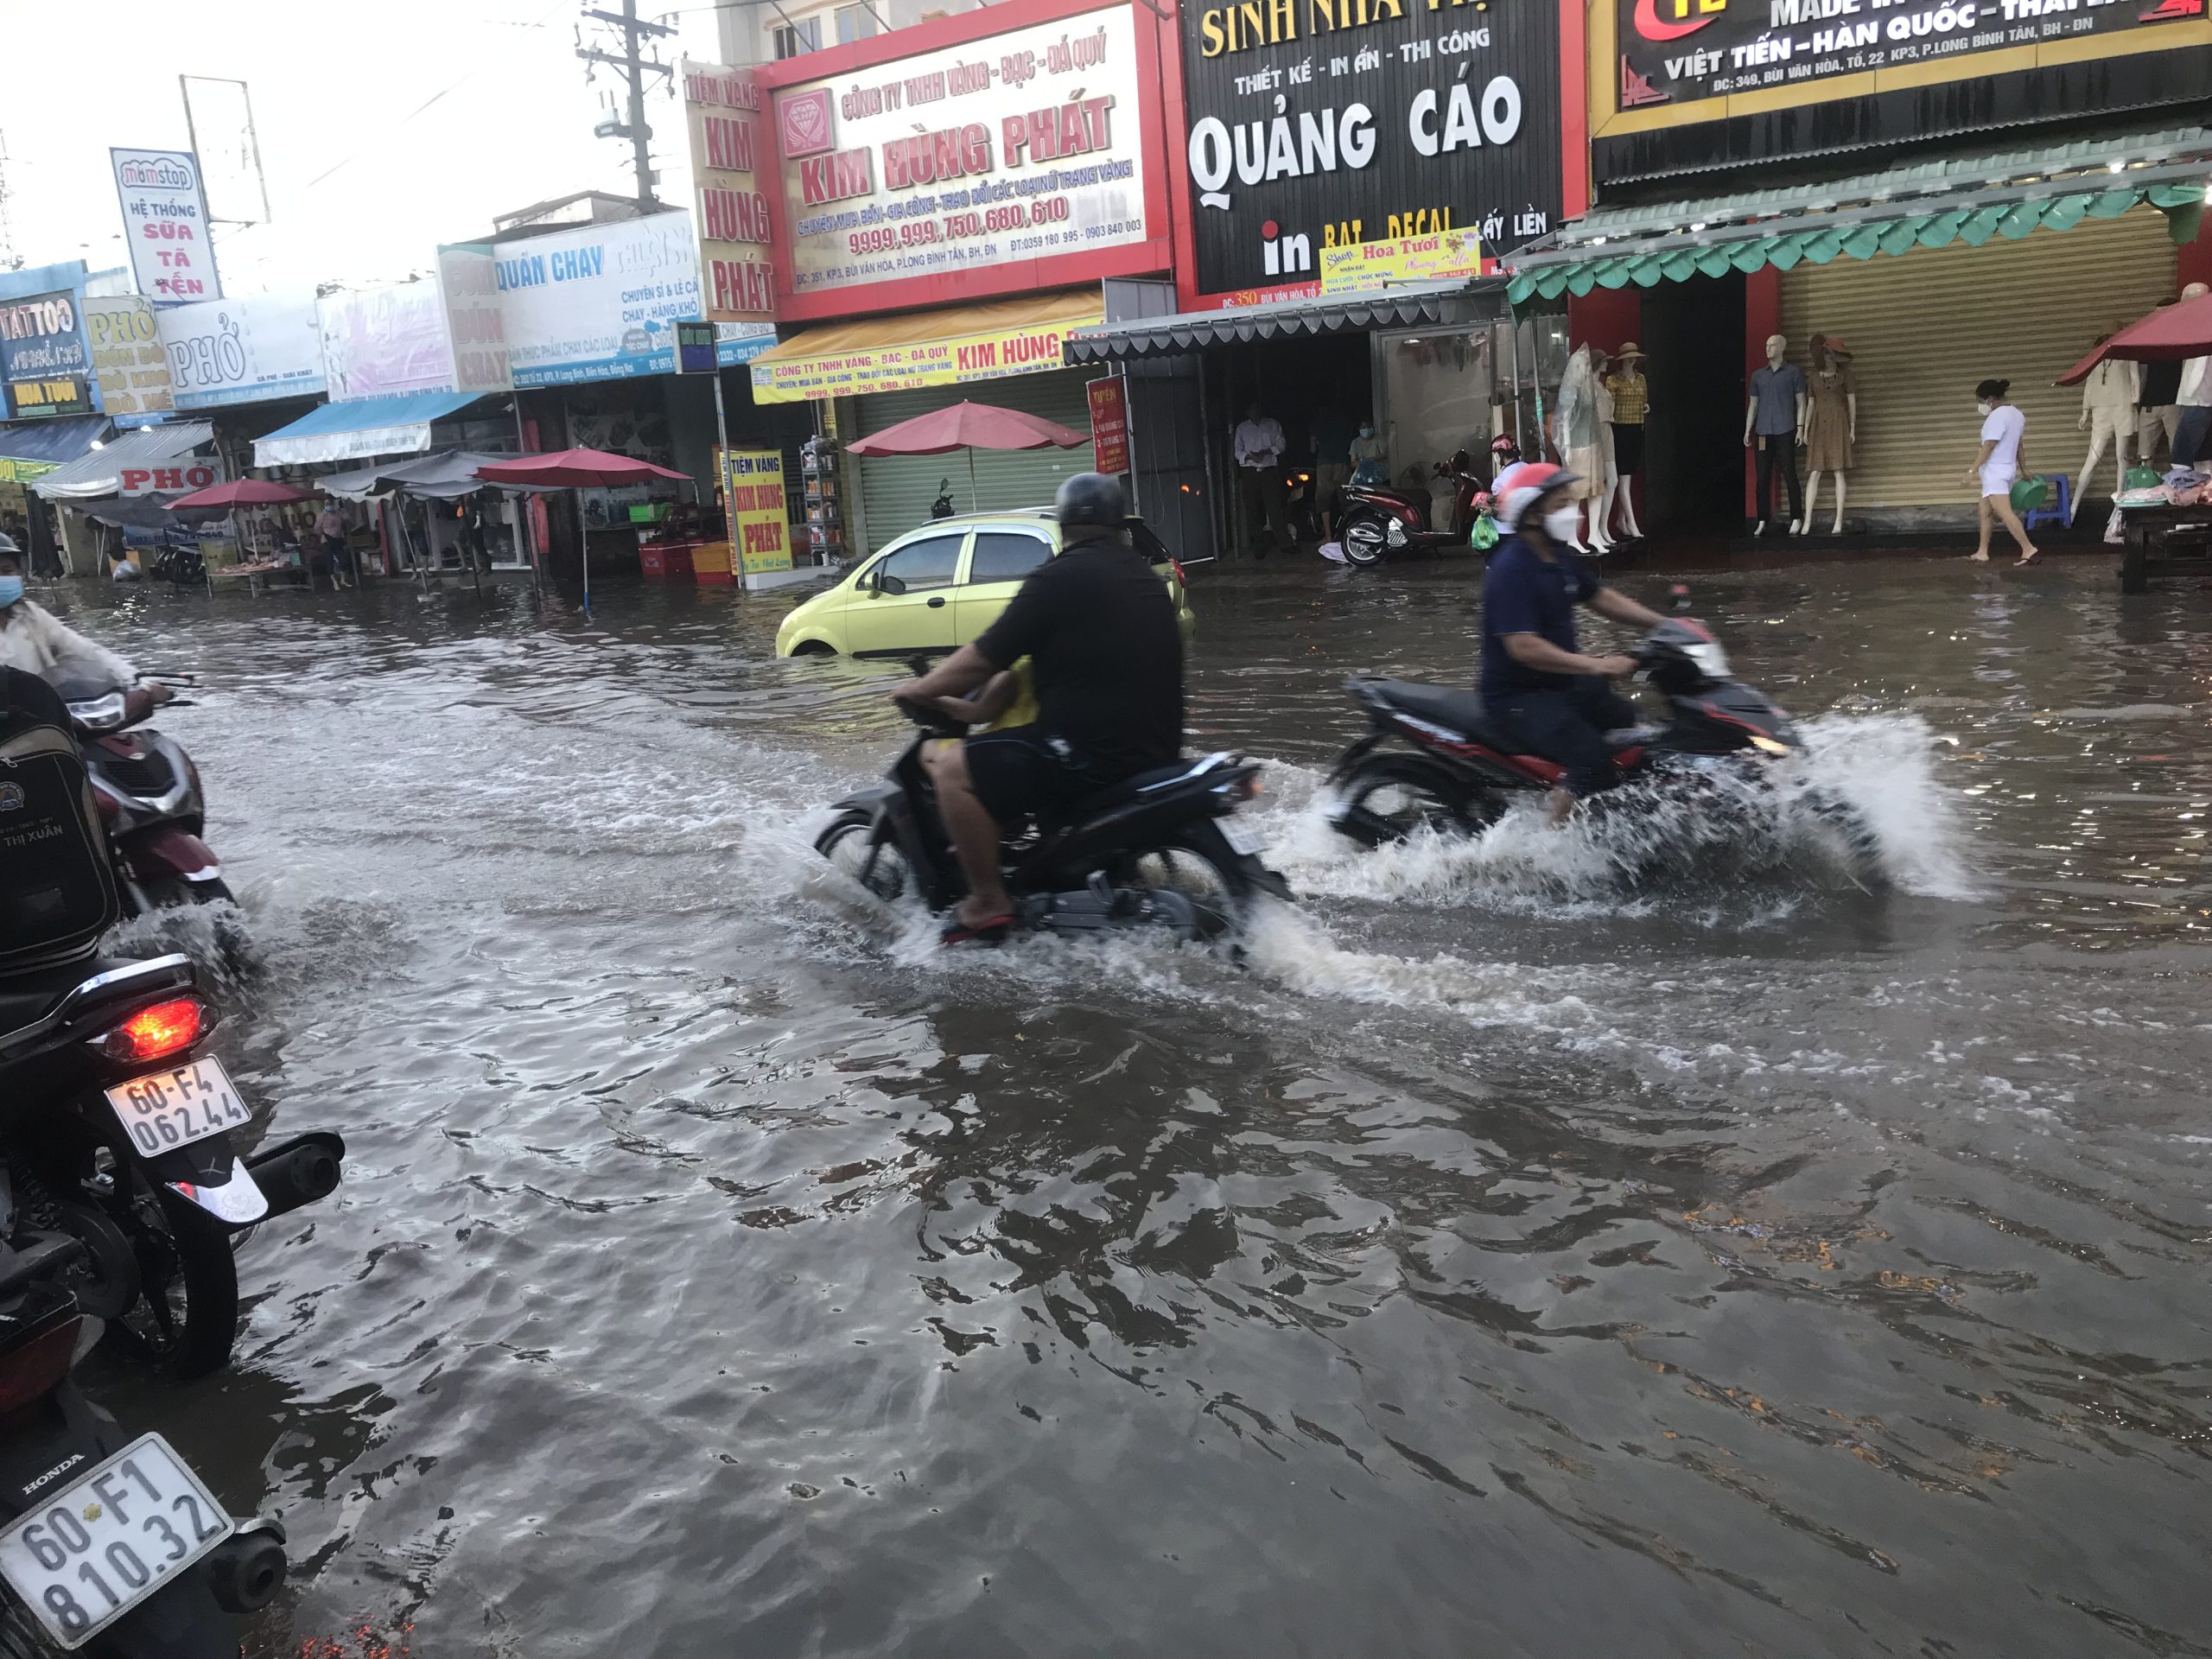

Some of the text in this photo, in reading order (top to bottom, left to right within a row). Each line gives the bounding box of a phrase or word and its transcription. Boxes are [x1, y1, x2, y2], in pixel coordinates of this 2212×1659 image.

[1202, 0, 1298, 57] SINH
[1664, 0, 1976, 82] VIỆT TIẾN HÀN QUỐC
[842, 25, 1107, 121] CÔNG TY TNHH VÀNG BẠC ĐÁ QUÝ
[1234, 28, 1491, 96] THIẾT KẾ IN ẤN THI CÔNG
[1736, 74, 1762, 87] 349,
[1764, 68, 1783, 83] BÙI
[1789, 64, 1811, 79] VĂN
[1815, 57, 1844, 74] HÒA,
[1868, 52, 1885, 65] 22
[1891, 45, 1920, 61] KP3,
[1923, 35, 1968, 55] P.LONG
[1973, 31, 2005, 48] BÌNH
[2008, 22, 2038, 41] TÂN,
[2043, 22, 2062, 36] BH
[2073, 16, 2094, 31] ĐN
[683, 69, 760, 111] TIỆM VÀNG
[702, 116, 754, 172] KIM
[799, 87, 1116, 206] KIM HÙNG PHÁT
[1188, 62, 1522, 211] QUẢNG CÁO
[992, 179, 1015, 202] CÁC
[1057, 167, 1099, 189] TRANG
[1098, 158, 1134, 181] VÀNG
[130, 198, 196, 219] HỆ THỐNG
[143, 220, 194, 240] SỮA
[700, 177, 771, 244] HÙNG
[156, 248, 190, 267] TÃ
[845, 264, 859, 277] BÙI
[860, 262, 875, 276] VĂN
[926, 250, 947, 265] BÌNH
[947, 248, 967, 263] TÂN,
[984, 243, 996, 256] ĐN
[1045, 233, 1059, 245] 180
[1063, 231, 1078, 243] 995
[1085, 226, 1106, 239] 0903
[1108, 222, 1123, 235] 840
[1126, 219, 1141, 232] 003
[1262, 220, 1311, 276] in
[1476, 207, 1503, 242] LẤY
[1515, 204, 1547, 237] LIỀN
[1326, 236, 1440, 266] Shop Hoa Tươi
[494, 250, 546, 290] QUÁN
[551, 245, 602, 282] CHAY
[709, 252, 774, 313] PHÁT
[621, 286, 654, 303] CHUYÊN
[622, 297, 697, 323] CHAY HÀNG KHÔ
[1236, 290, 1257, 308] 350
[1262, 291, 1272, 304] BÙI
[1274, 289, 1288, 302] VĂN
[1306, 283, 1316, 298] TỔ
[0, 298, 73, 340] TATTOO
[87, 298, 156, 345] PHỞ
[167, 312, 245, 388] PHỞ
[460, 350, 508, 385] CHAY
[775, 364, 802, 378] CÔNG
[804, 363, 815, 374] TY
[817, 359, 842, 372] TNHH
[845, 354, 872, 370] VÀNG
[881, 352, 902, 366] BẠC
[911, 346, 925, 361] ĐÁ
[957, 333, 1059, 372] KIM HÙNG
[904, 378, 923, 388] 610
[120, 461, 215, 490] PHỞ
[731, 455, 779, 477] TIỆM VÀNG
[734, 478, 784, 512] KIM HÙNG
[744, 515, 782, 554] PHÁT
[27, 823, 63, 842] XUÂN
[127, 1065, 213, 1115] 60-F4
[133, 1092, 242, 1151] 062.44
[22, 1452, 86, 1496] HONDA
[22, 1459, 162, 1572] 60F1
[42, 1494, 222, 1631] 810.32
